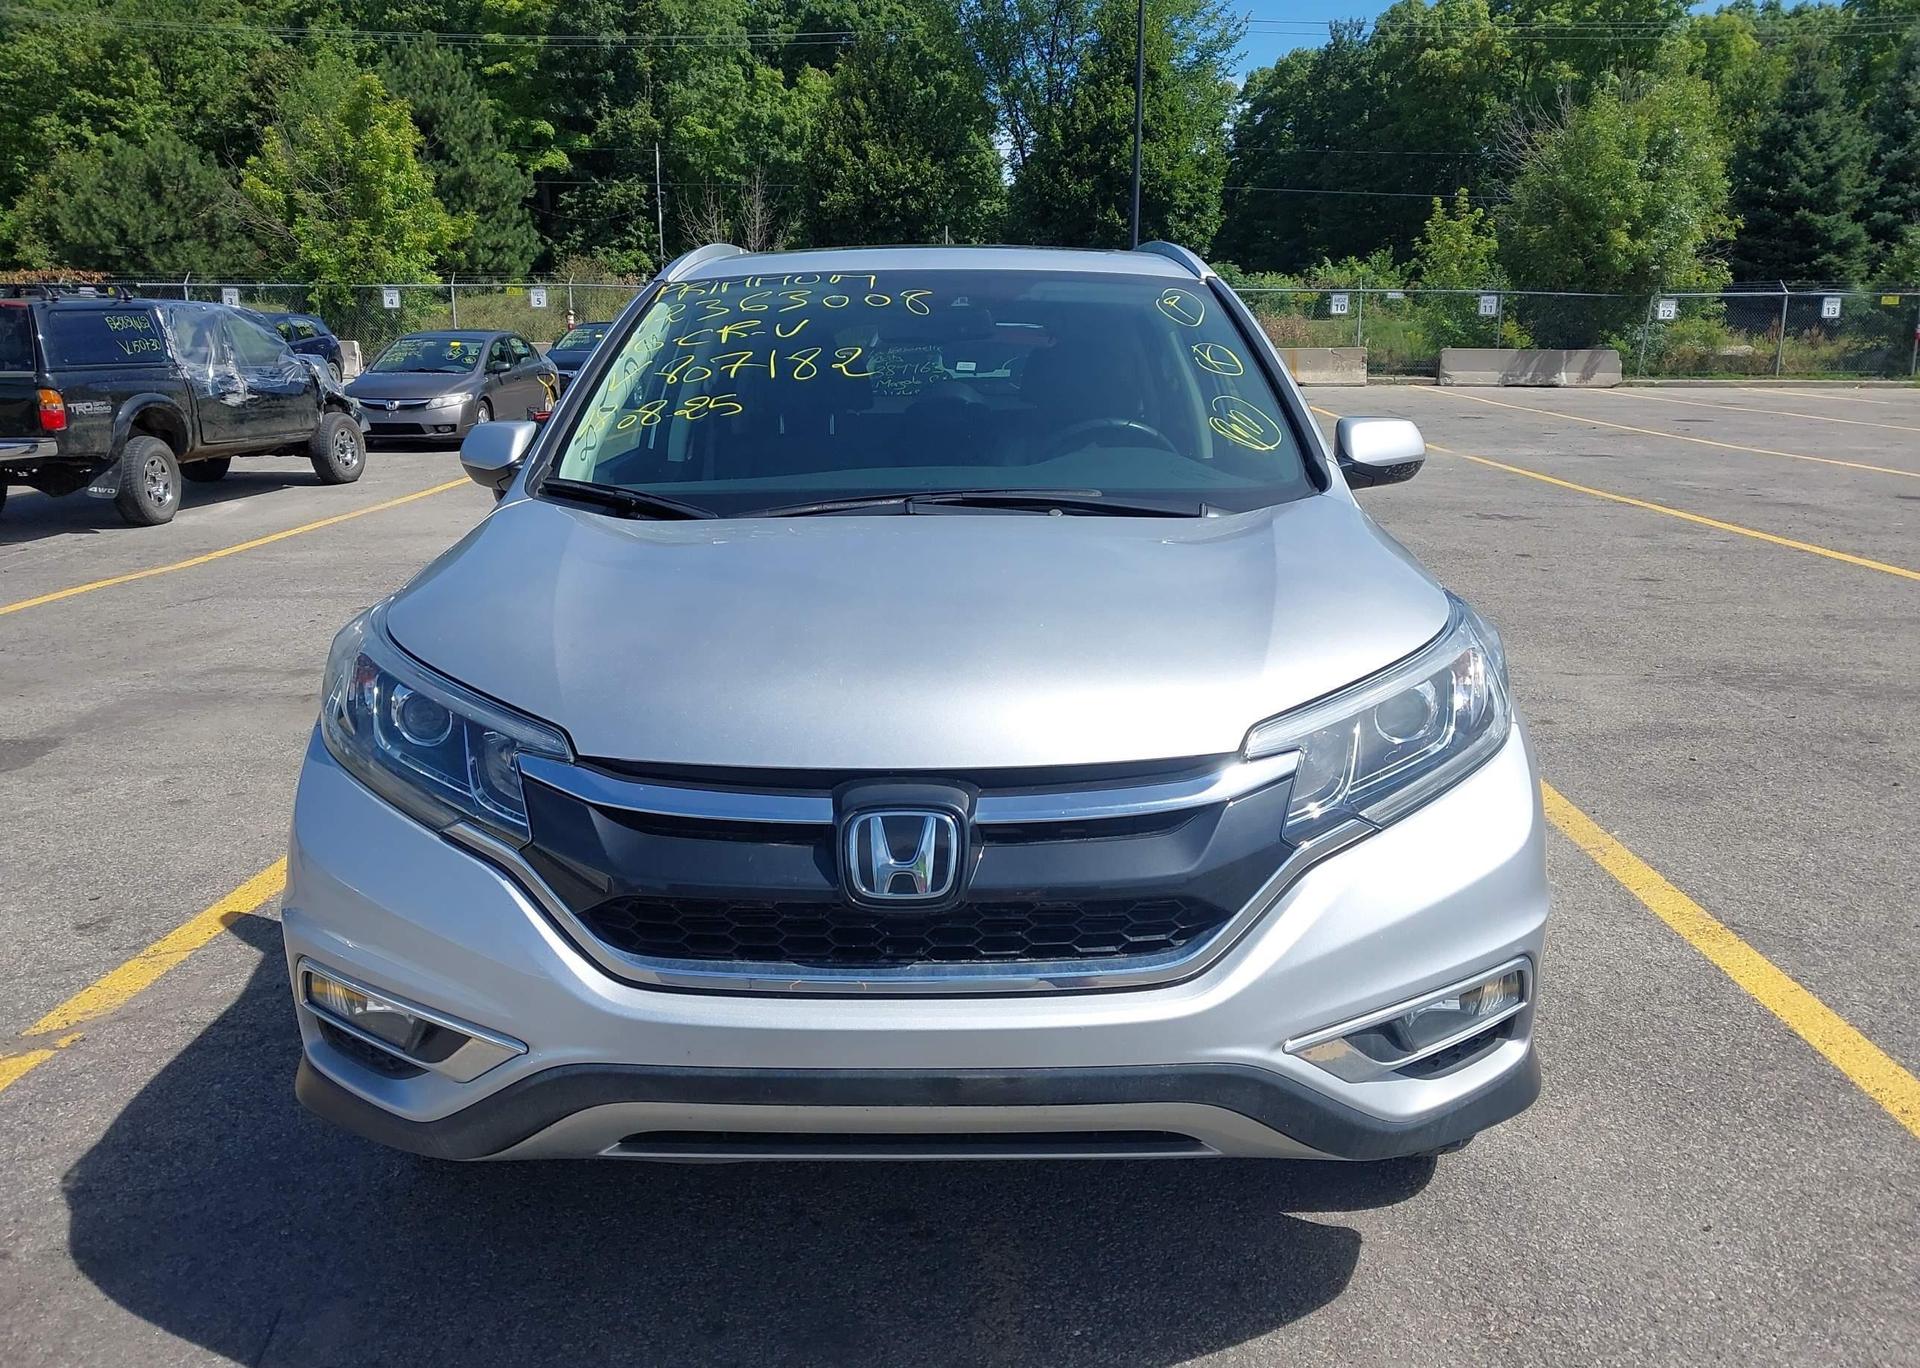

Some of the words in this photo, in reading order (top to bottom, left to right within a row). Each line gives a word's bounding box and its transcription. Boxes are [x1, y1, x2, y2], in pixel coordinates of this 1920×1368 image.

[1483, 305, 1493, 313] 11
[1661, 309, 1673, 317] 12
[1827, 307, 1837, 315] 13
[67, 402, 93, 415] TRD
[88, 486, 116, 494] 4WD
